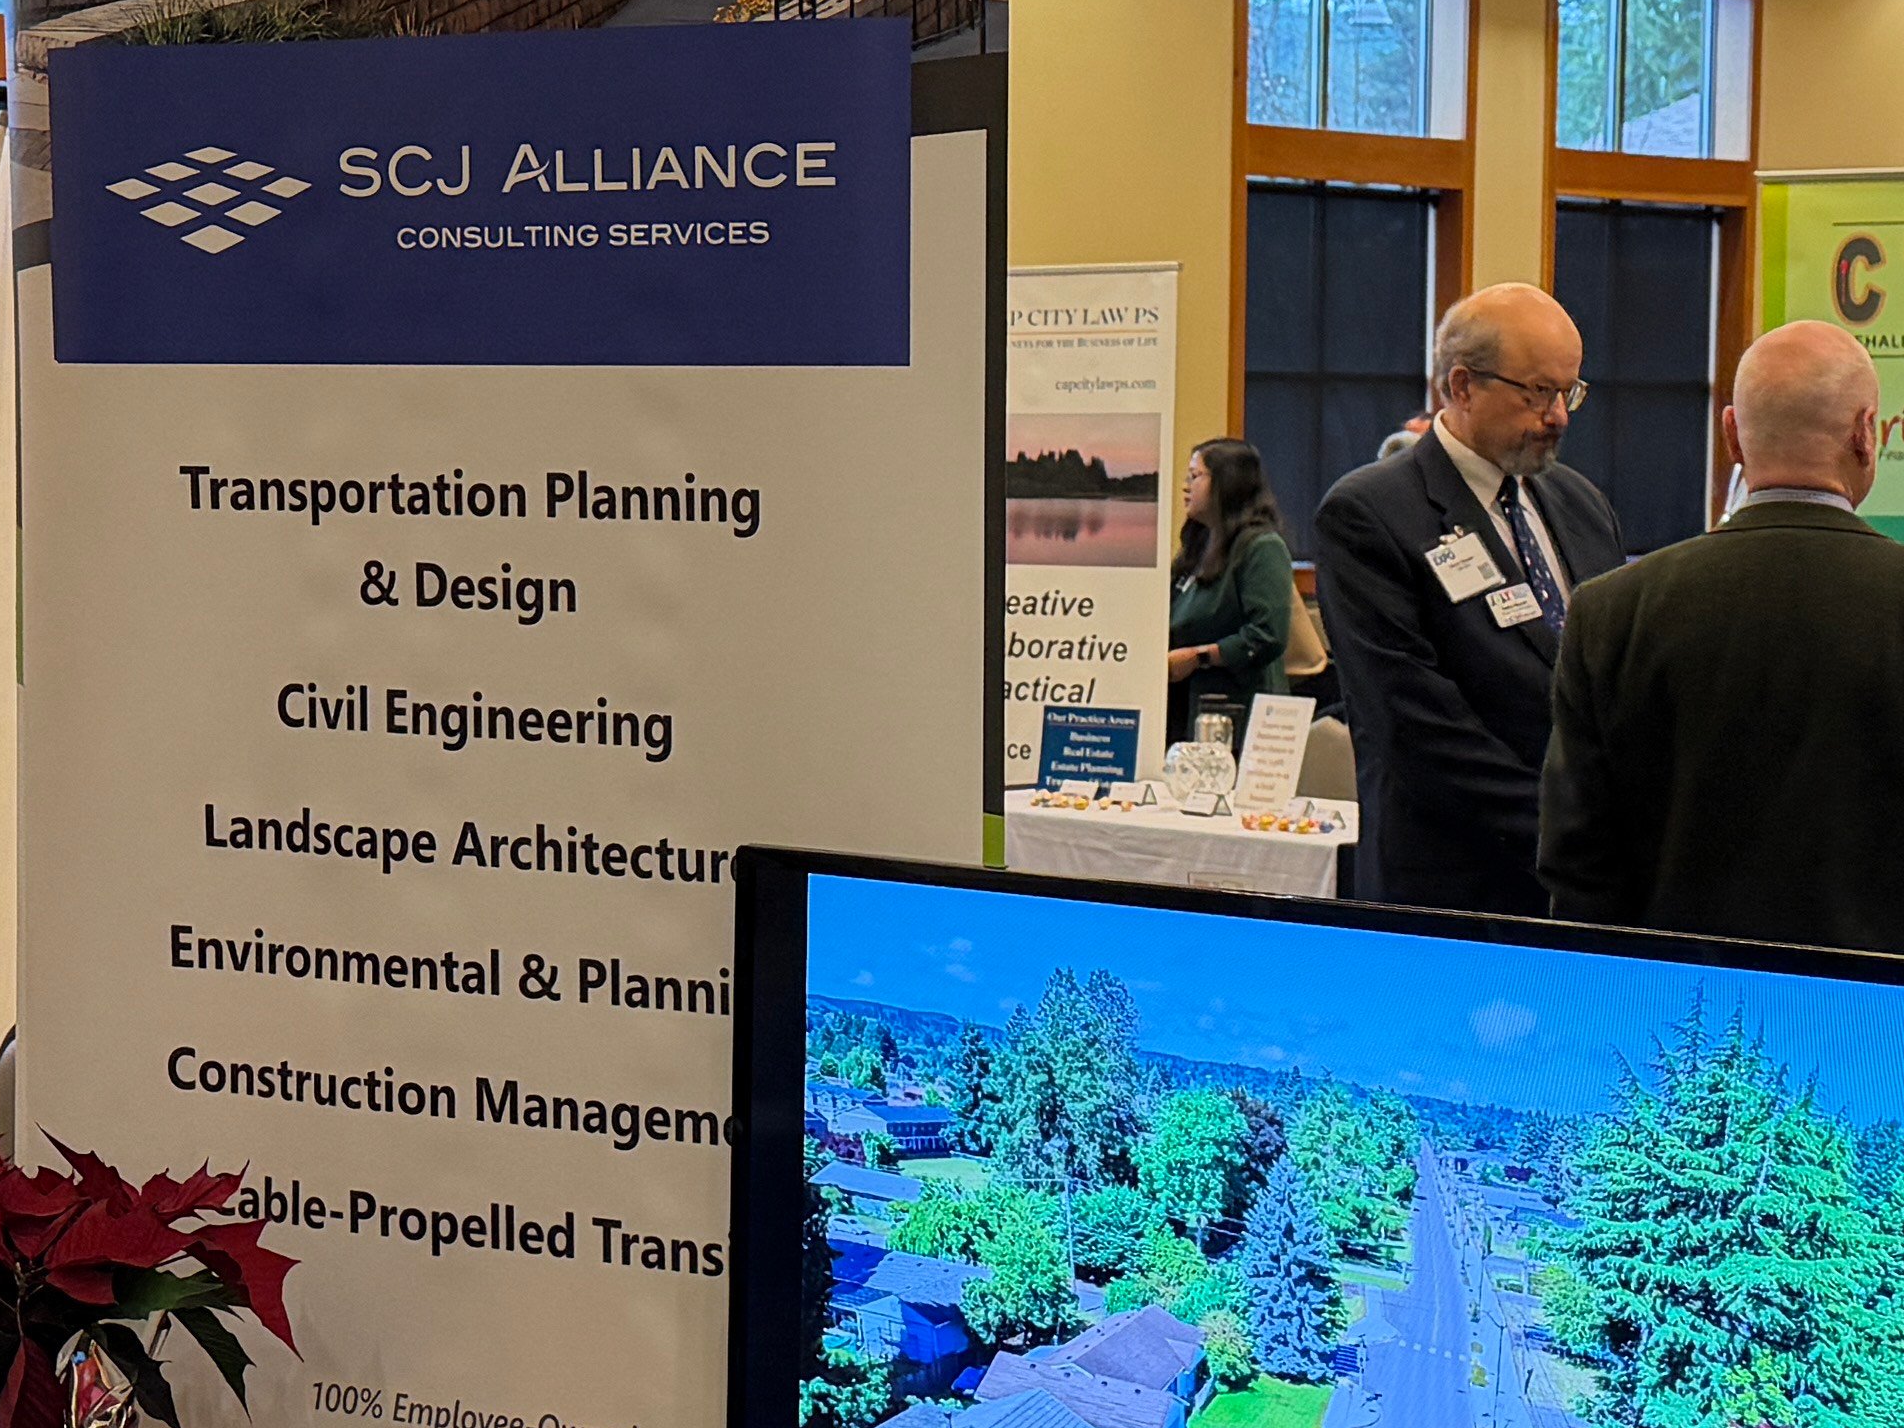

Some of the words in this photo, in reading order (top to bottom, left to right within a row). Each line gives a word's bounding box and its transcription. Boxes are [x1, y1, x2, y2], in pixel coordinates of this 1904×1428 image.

[338, 145, 471, 199] SCJ
[502, 142, 837, 195] ALLIANCE
[397, 224, 599, 250] CONSULTING
[608, 221, 770, 247] SERVICES
[1027, 307, 1078, 327] CITY
[1082, 306, 1129, 326] LAW
[1134, 305, 1160, 325] PS
[179, 465, 527, 526] Transportation
[546, 472, 762, 538] Planning
[360, 561, 399, 607] &
[416, 562, 577, 624] Design
[276, 682, 368, 732] Civil
[385, 689, 674, 762] Engineering
[203, 803, 437, 874] Landscape
[452, 820, 738, 885] Architectur
[169, 923, 500, 997] Environmental
[518, 952, 561, 1002] &
[578, 958, 730, 1016] Planni
[167, 1045, 457, 1119] Construction
[475, 1075, 741, 1151] Managem
[216, 1177, 576, 1260] able-Propelled
[592, 1215, 729, 1278] Trans
[311, 1381, 384, 1420] 100%
